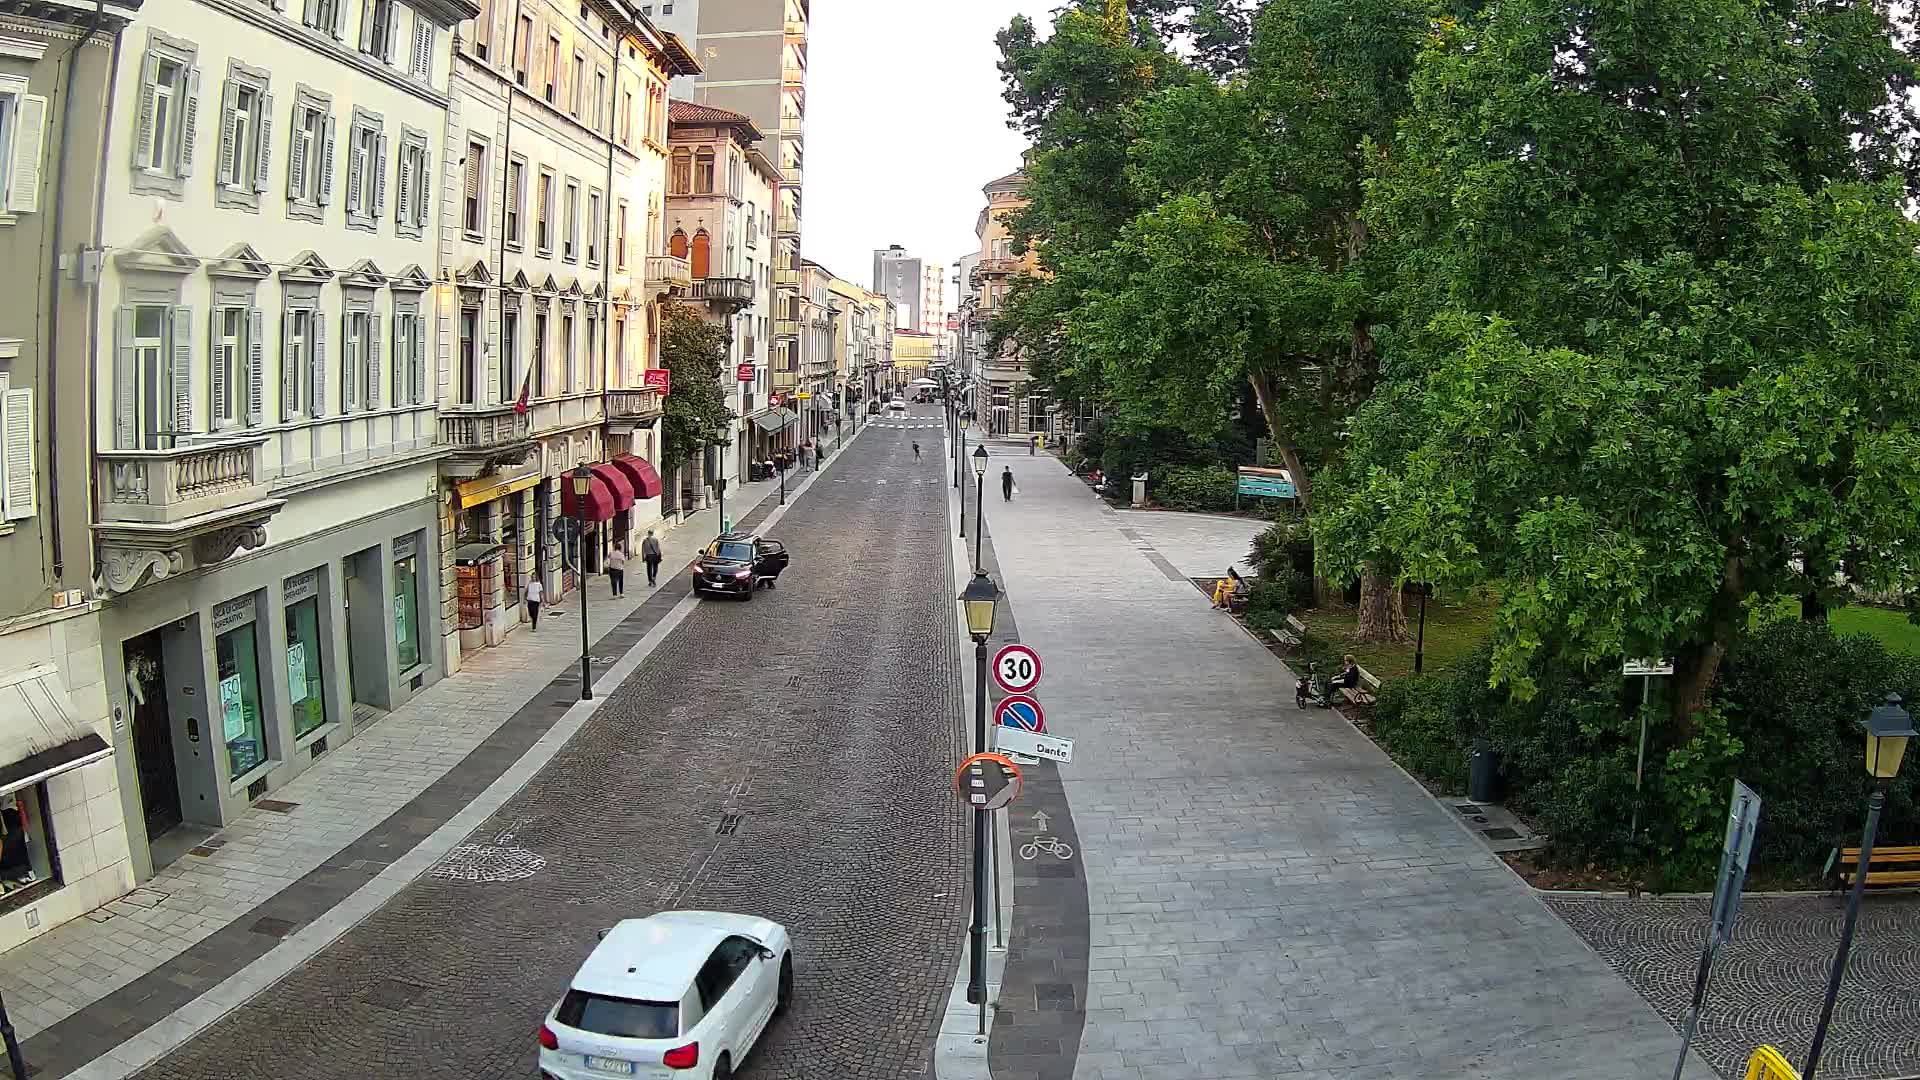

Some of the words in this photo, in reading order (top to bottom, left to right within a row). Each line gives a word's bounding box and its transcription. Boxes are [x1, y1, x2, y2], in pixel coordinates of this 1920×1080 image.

[1004, 657, 1032, 680] 30
[220, 678, 240, 700] 130
[1037, 744, 1067, 758] Dante
